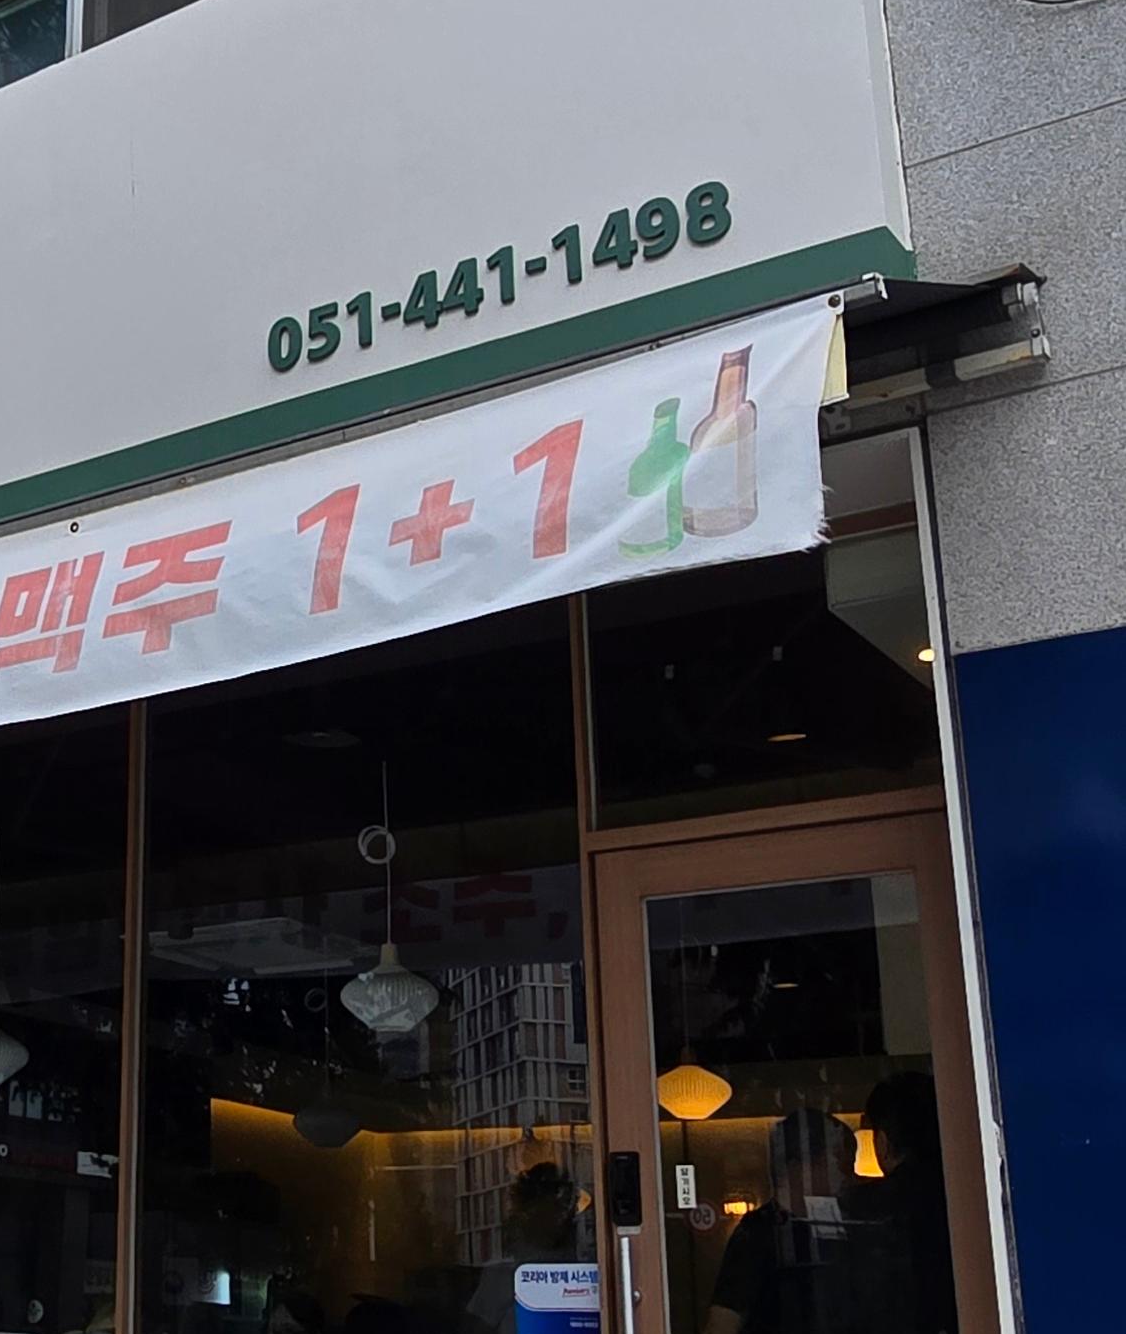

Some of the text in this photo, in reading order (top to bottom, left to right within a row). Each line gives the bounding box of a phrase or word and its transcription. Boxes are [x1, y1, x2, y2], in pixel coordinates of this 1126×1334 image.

[267, 180, 732, 373] 051-441-1498
[295, 418, 585, 617] 1+1
[521, 1270, 548, 1284] 코리아
